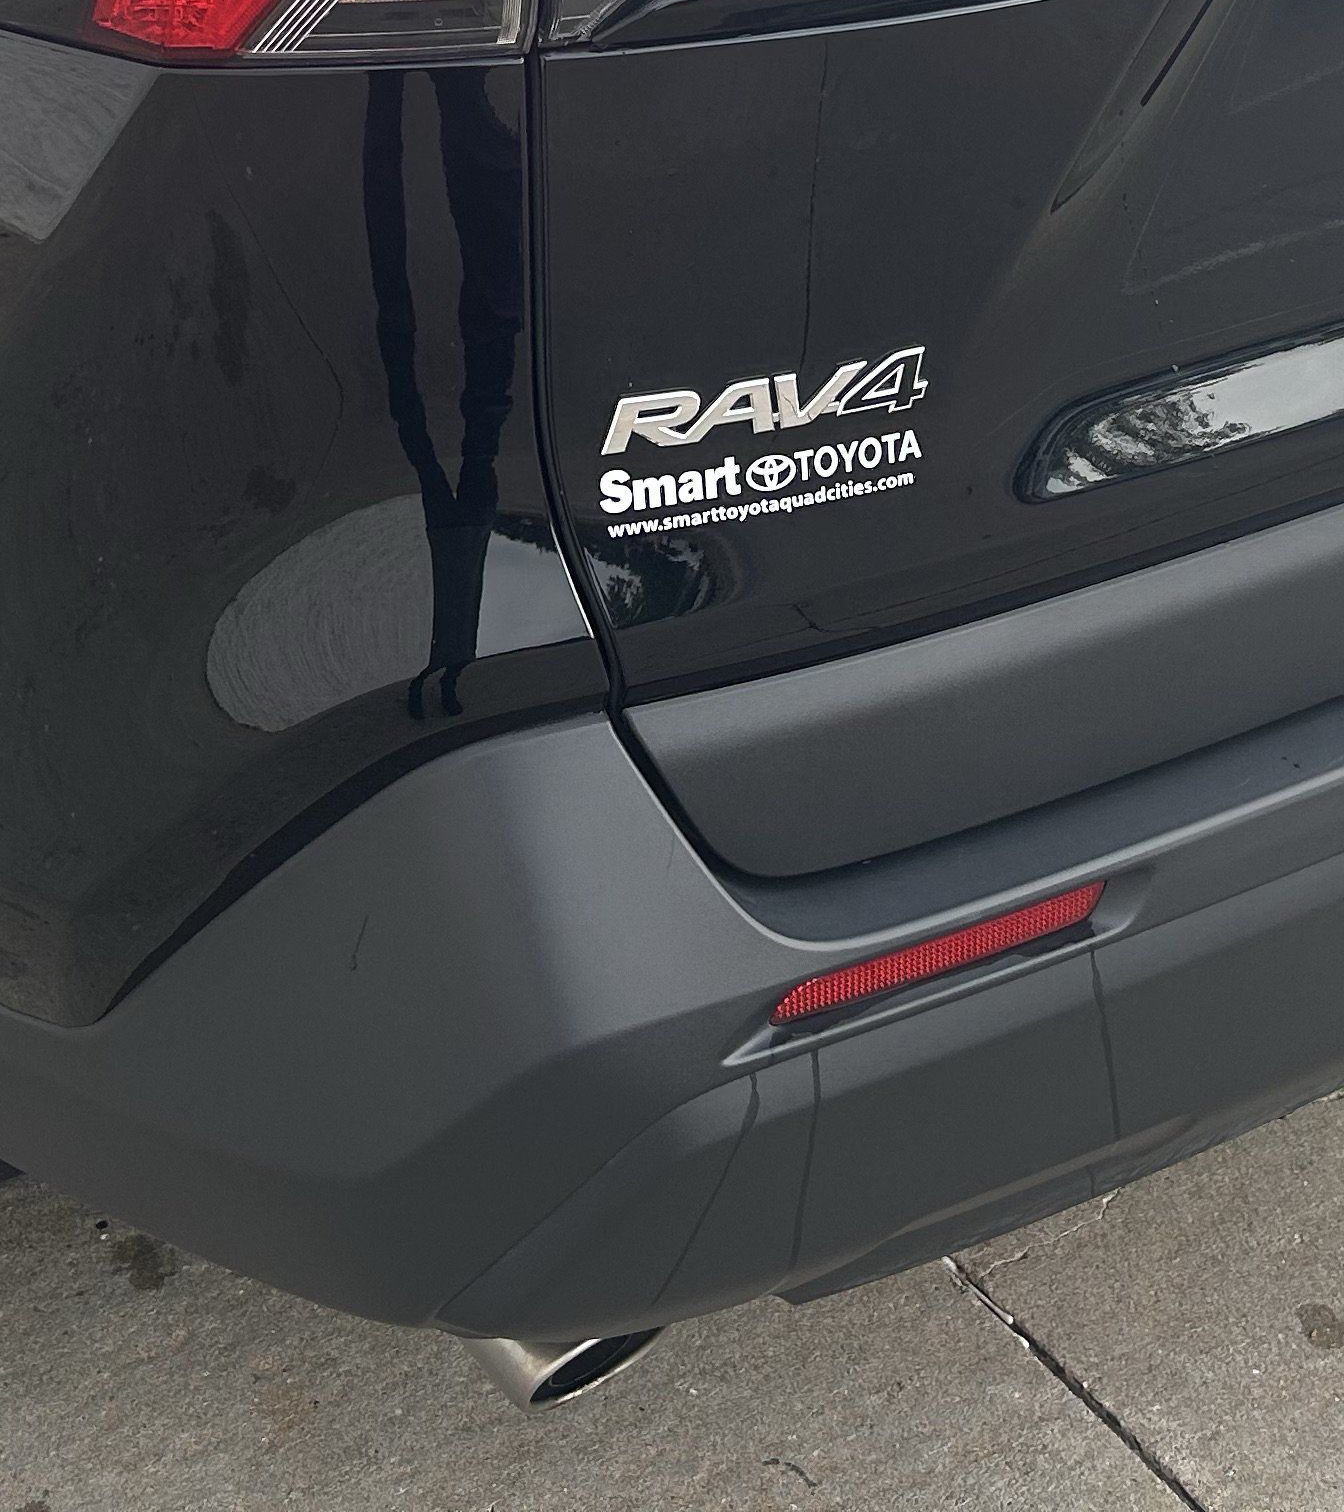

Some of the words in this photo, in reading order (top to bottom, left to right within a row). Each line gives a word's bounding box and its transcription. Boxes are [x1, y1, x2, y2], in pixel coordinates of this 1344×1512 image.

[600, 344, 929, 456] RAV4
[599, 456, 742, 514] Smart
[794, 429, 923, 482] TOYOTA
[607, 472, 916, 539] www.smarttoyotaquadcities.com
